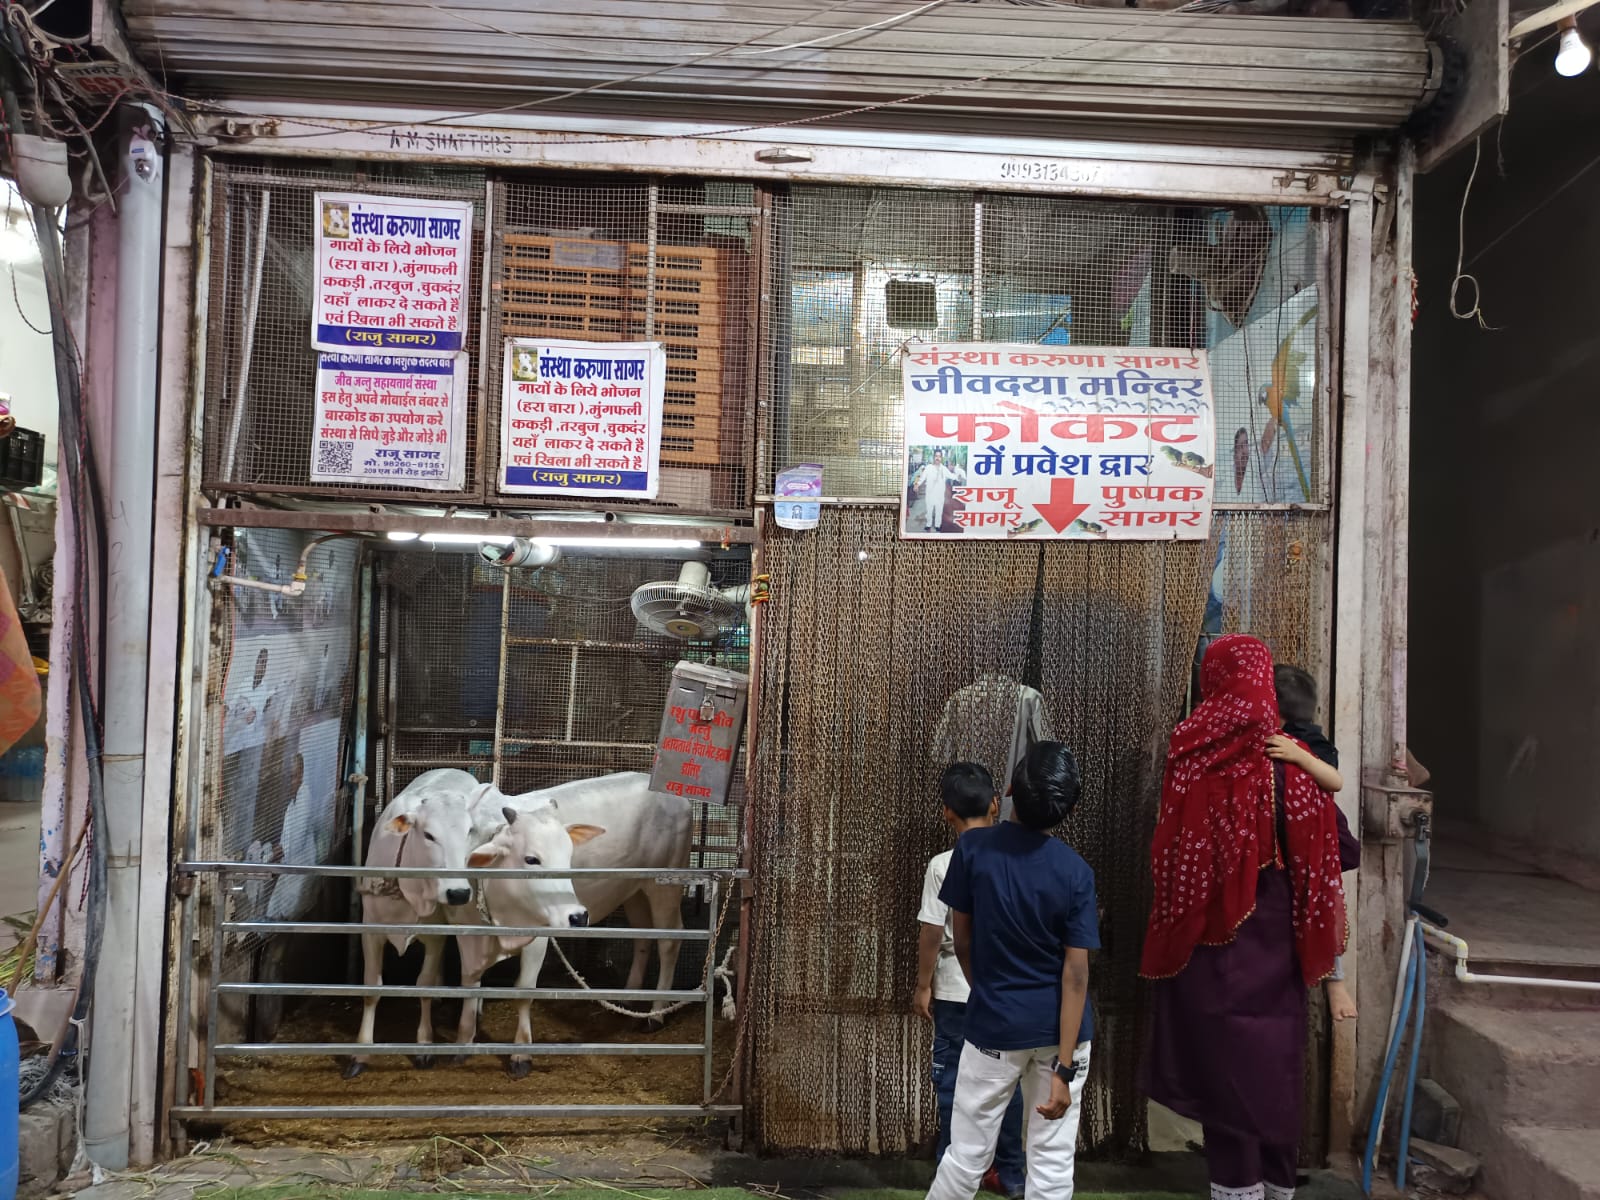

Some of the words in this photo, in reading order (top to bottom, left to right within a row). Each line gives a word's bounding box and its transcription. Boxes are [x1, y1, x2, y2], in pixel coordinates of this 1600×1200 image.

[352, 204, 384, 235] संस्था
[387, 215, 426, 238] करुणा
[429, 218, 461, 240] सागर
[330, 238, 363, 251] गायों
[367, 239, 380, 253] के
[384, 240, 411, 255] लिये
[414, 242, 458, 257] भोजन
[329, 256, 357, 271] (हरा
[361, 261, 388, 272] चारा
[323, 275, 365, 291] ककड़ी
[324, 292, 352, 306] यहाँ
[357, 297, 396, 309] लाकर
[399, 297, 408, 310] दे
[412, 298, 447, 312] सकते
[325, 310, 344, 324] एवं
[347, 311, 385, 326] खिला
[388, 313, 405, 327] भी
[409, 315, 444, 329] सकते
[387, 332, 437, 345] सागर)
[539, 348, 571, 379] संस्था
[574, 358, 613, 380] करुणा
[614, 359, 645, 380] सागर
[910, 346, 1000, 366] संस्था
[1008, 352, 1105, 367] करुणा
[1115, 354, 1200, 369] सागर
[335, 371, 352, 387] जीव
[414, 375, 437, 390] संस्था
[518, 380, 551, 394] गायों
[554, 381, 568, 396] के
[571, 382, 597, 397] लिये
[601, 384, 641, 398] भोजन
[911, 366, 1068, 396] जीवदया
[1078, 369, 1204, 397] मन्दिर
[322, 391, 336, 404] इस
[338, 388, 353, 408] हेतु
[355, 390, 378, 406] अपने
[440, 393, 449, 408] से
[517, 399, 545, 413] (हरा
[549, 403, 575, 414] चारा
[325, 407, 367, 423] बारकोड
[369, 411, 384, 423] का
[386, 409, 425, 425] उपयोग
[512, 417, 552, 434] ककड़ी
[920, 400, 1200, 443] फोकट
[320, 424, 346, 440] संस्था
[348, 425, 357, 440] से
[398, 427, 413, 443] और
[436, 428, 447, 444] भी
[512, 434, 539, 449] यहाँ
[545, 438, 582, 450] लाकर
[585, 438, 594, 451] दे
[597, 439, 633, 452] सकते
[375, 449, 402, 462] राजू
[403, 450, 441, 459] सागर
[513, 452, 532, 466] एवं
[535, 452, 571, 467] खिला
[575, 454, 592, 468] भी
[594, 456, 629, 469] सकते
[974, 445, 1007, 476] में
[1012, 445, 1091, 476] प्रवेश
[1100, 454, 1155, 477] द्वार
[572, 472, 622, 485] सागर)
[953, 486, 1023, 509] राजू
[1100, 486, 1206, 508] पुष्पक
[953, 511, 1022, 527] सागर
[1099, 511, 1203, 527] सागर
